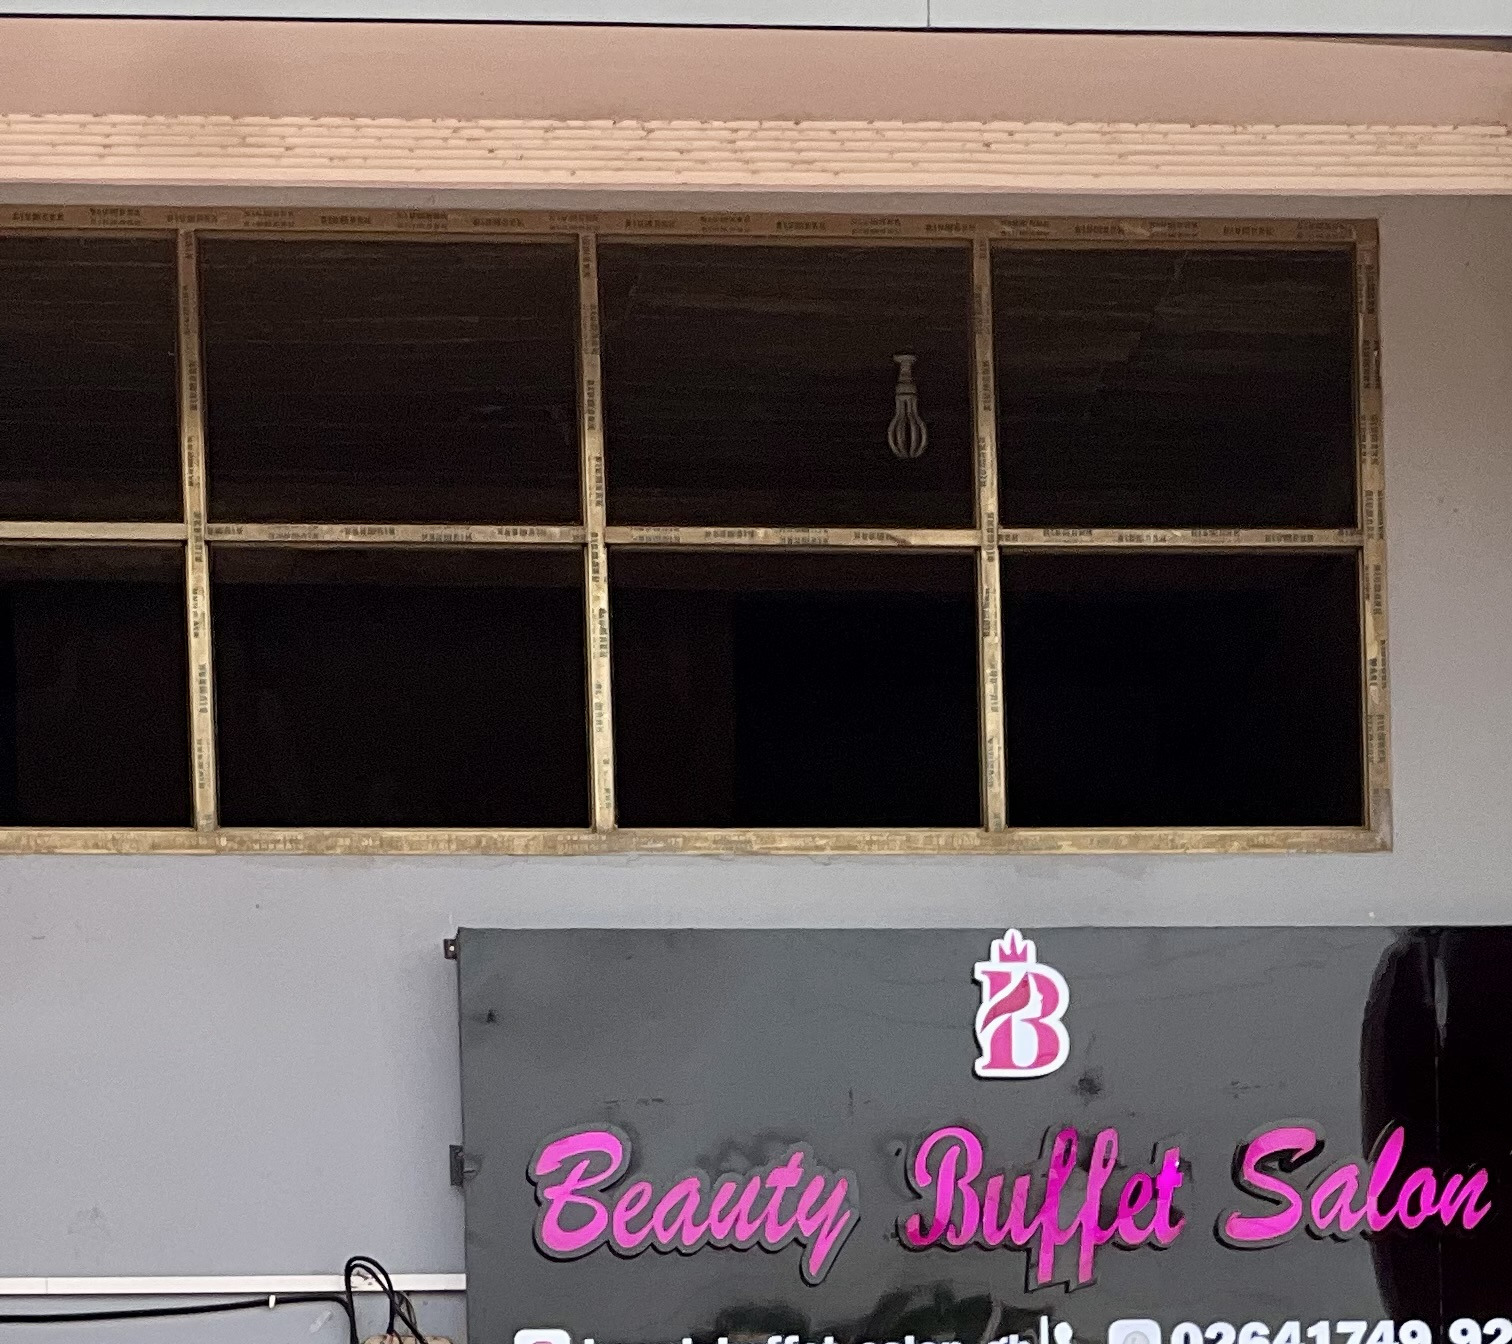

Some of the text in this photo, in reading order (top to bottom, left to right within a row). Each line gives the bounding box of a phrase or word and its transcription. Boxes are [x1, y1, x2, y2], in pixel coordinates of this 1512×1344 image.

[534, 1125, 1493, 1285] Beauty Buffet Salon
